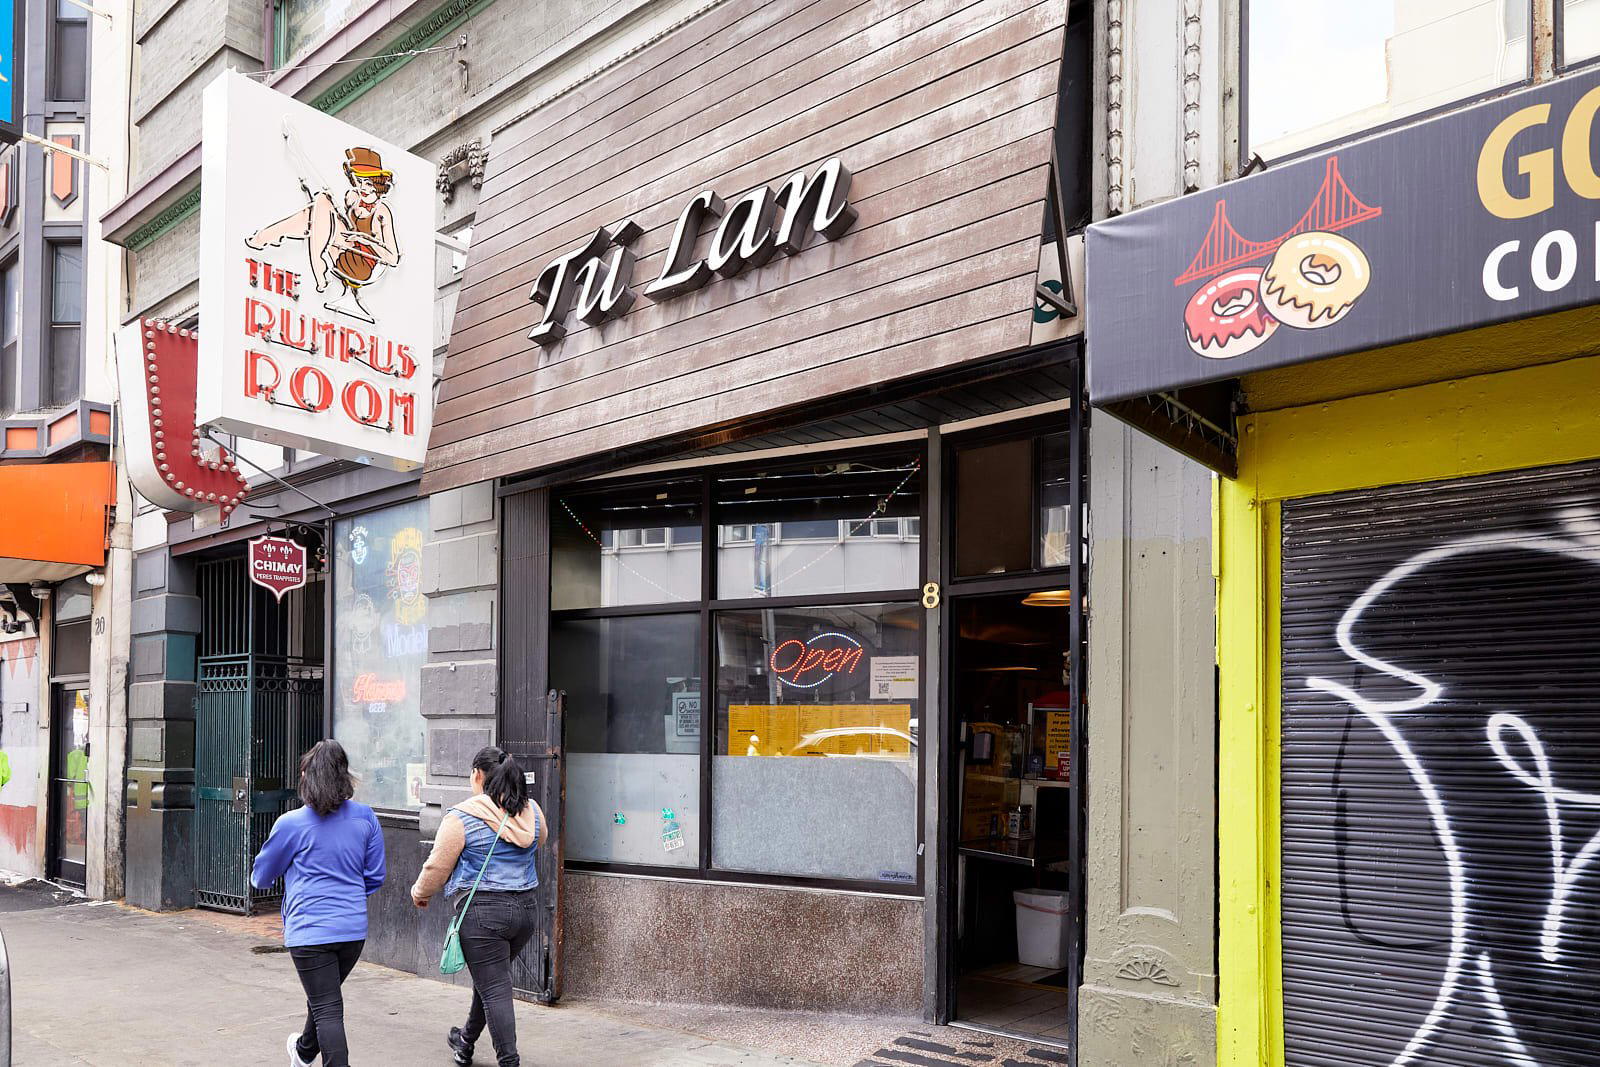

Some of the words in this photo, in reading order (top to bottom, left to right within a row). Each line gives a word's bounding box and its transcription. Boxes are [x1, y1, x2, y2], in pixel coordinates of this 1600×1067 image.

[643, 157, 856, 300] Lan
[245, 258, 301, 300] THE
[1482, 221, 1600, 301] CO
[244, 297, 418, 380] RUMPUS
[244, 349, 417, 437] ROOM
[254, 559, 303, 574] CHIMAY
[922, 582, 940, 609] 8
[95, 616, 106, 636] 20
[385, 623, 428, 658] Model
[770, 639, 863, 684] Open
